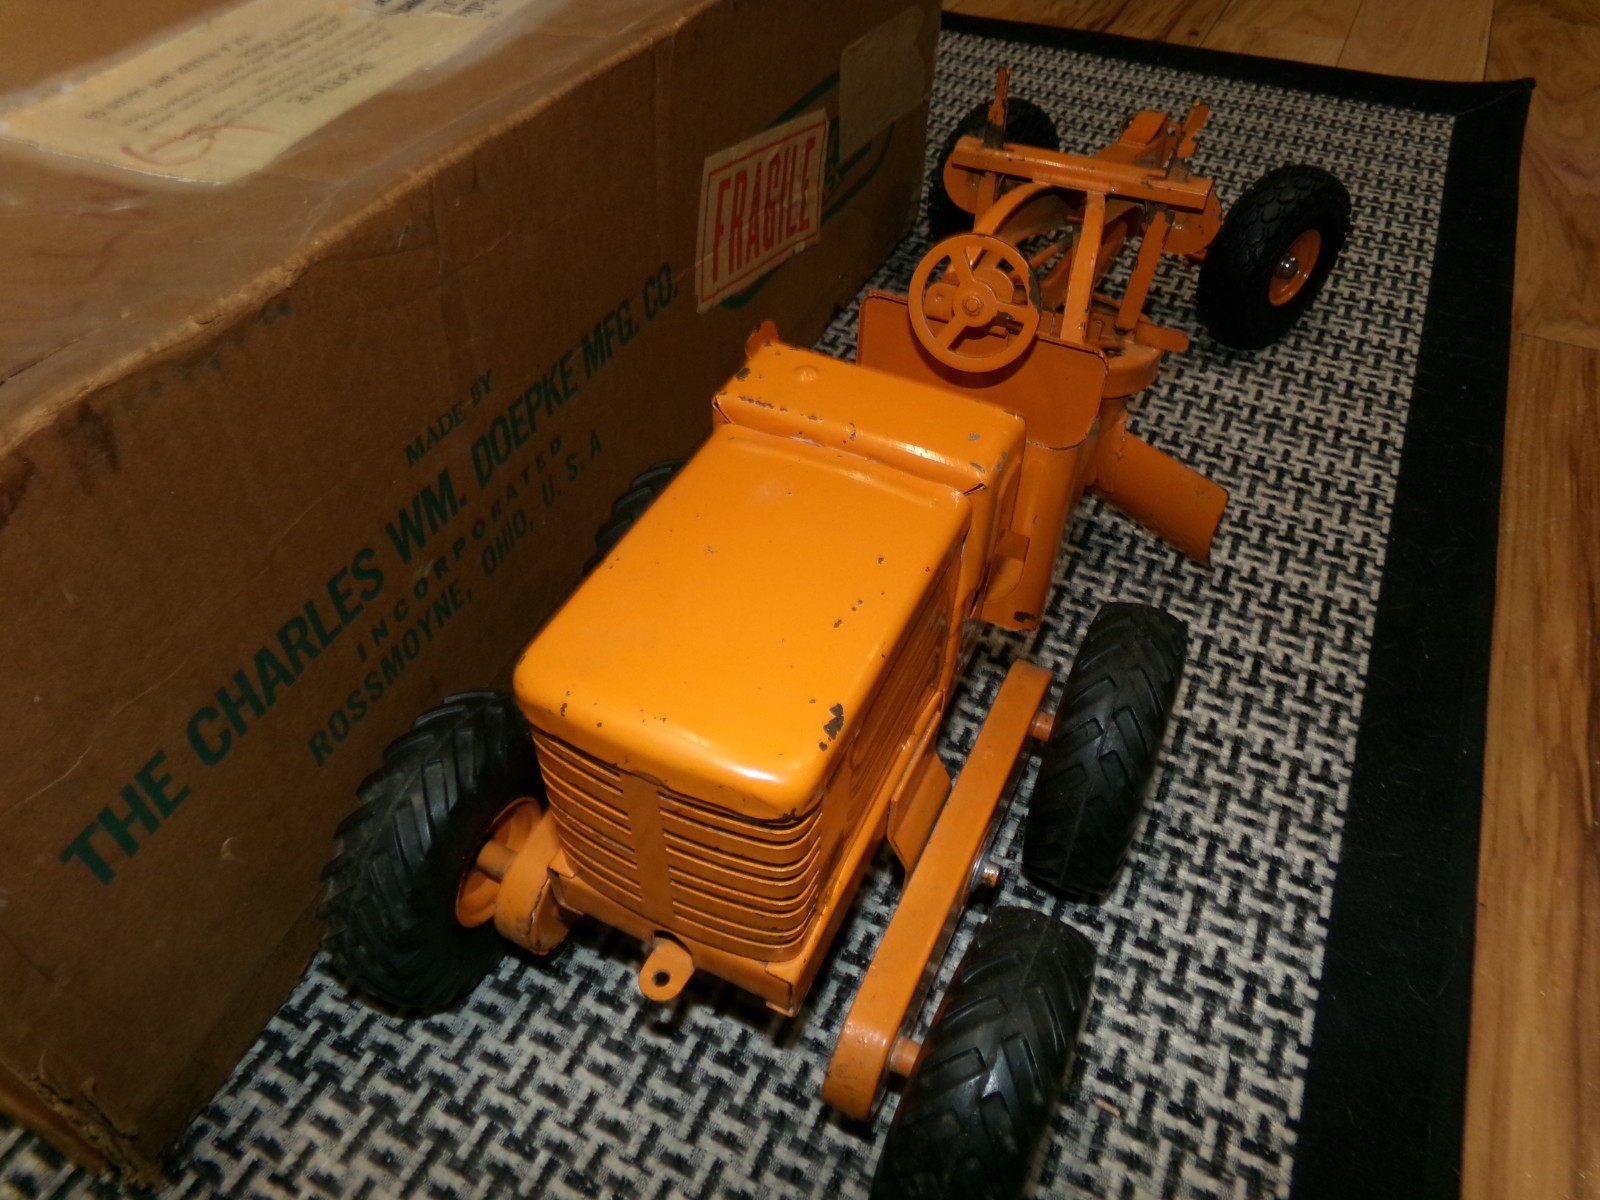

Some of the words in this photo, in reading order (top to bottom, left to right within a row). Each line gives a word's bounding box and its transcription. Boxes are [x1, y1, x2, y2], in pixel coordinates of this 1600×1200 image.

[712, 136, 816, 283] FRAGILE
[404, 402, 467, 468] MADE
[470, 368, 493, 405] BY
[59, 752, 191, 886] THE
[186, 548, 387, 767] CHARLES
[384, 467, 467, 565] WM.
[470, 351, 579, 490] DOEPKE
[580, 299, 640, 380] MFG.
[641, 262, 680, 322] CO.
[307, 580, 473, 768] ROSSMOYNE,
[479, 509, 535, 578] OHIO,
[356, 437, 562, 663] INCORPORATED
